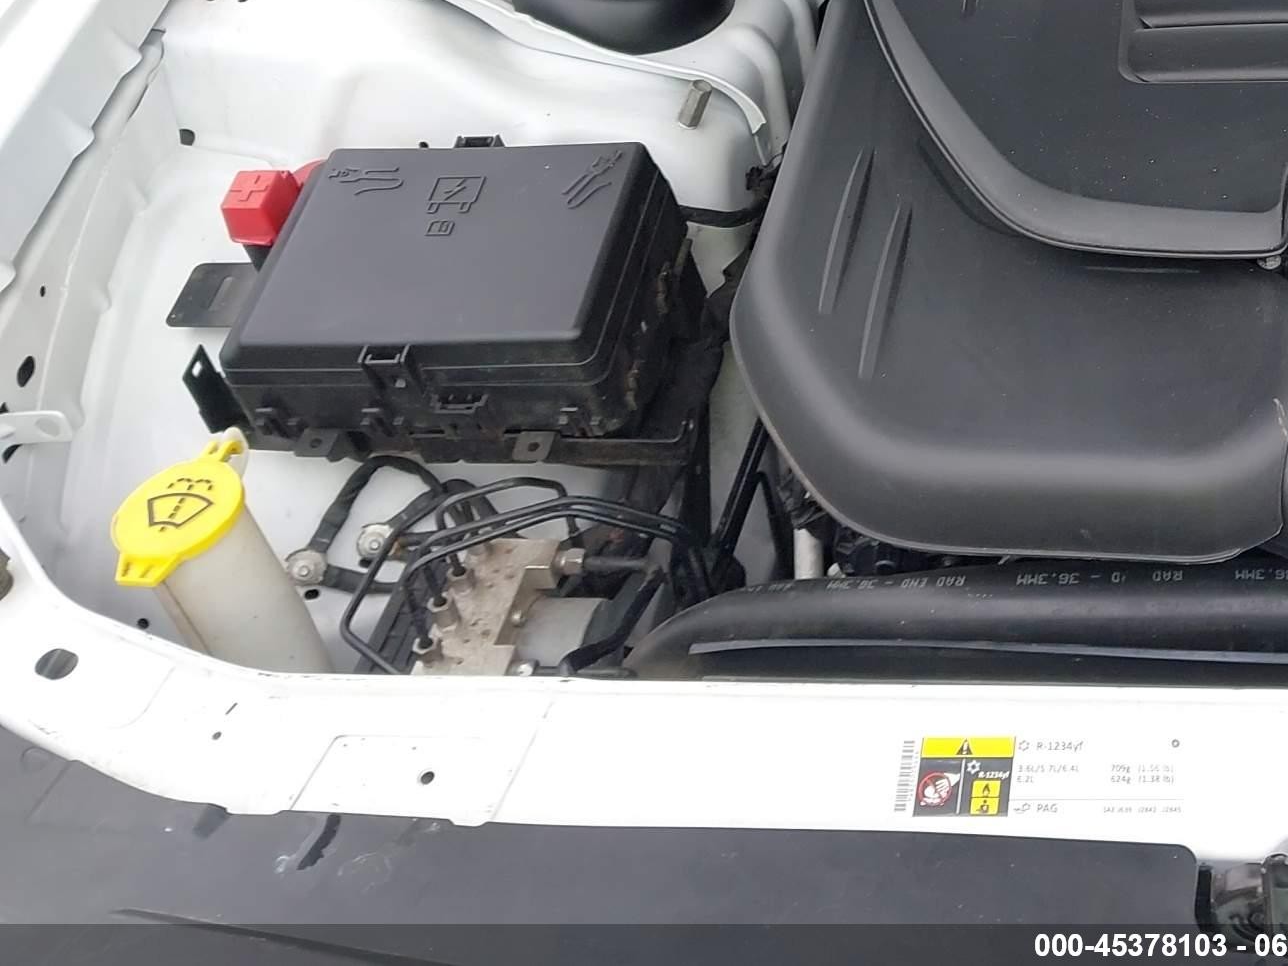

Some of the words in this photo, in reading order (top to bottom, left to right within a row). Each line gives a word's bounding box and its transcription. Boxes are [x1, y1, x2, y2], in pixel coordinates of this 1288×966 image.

[936, 575, 967, 587] RAD
[1015, 572, 1081, 586] 36.3MM
[1152, 570, 1184, 582] RAD
[1036, 802, 1059, 814] PAG
